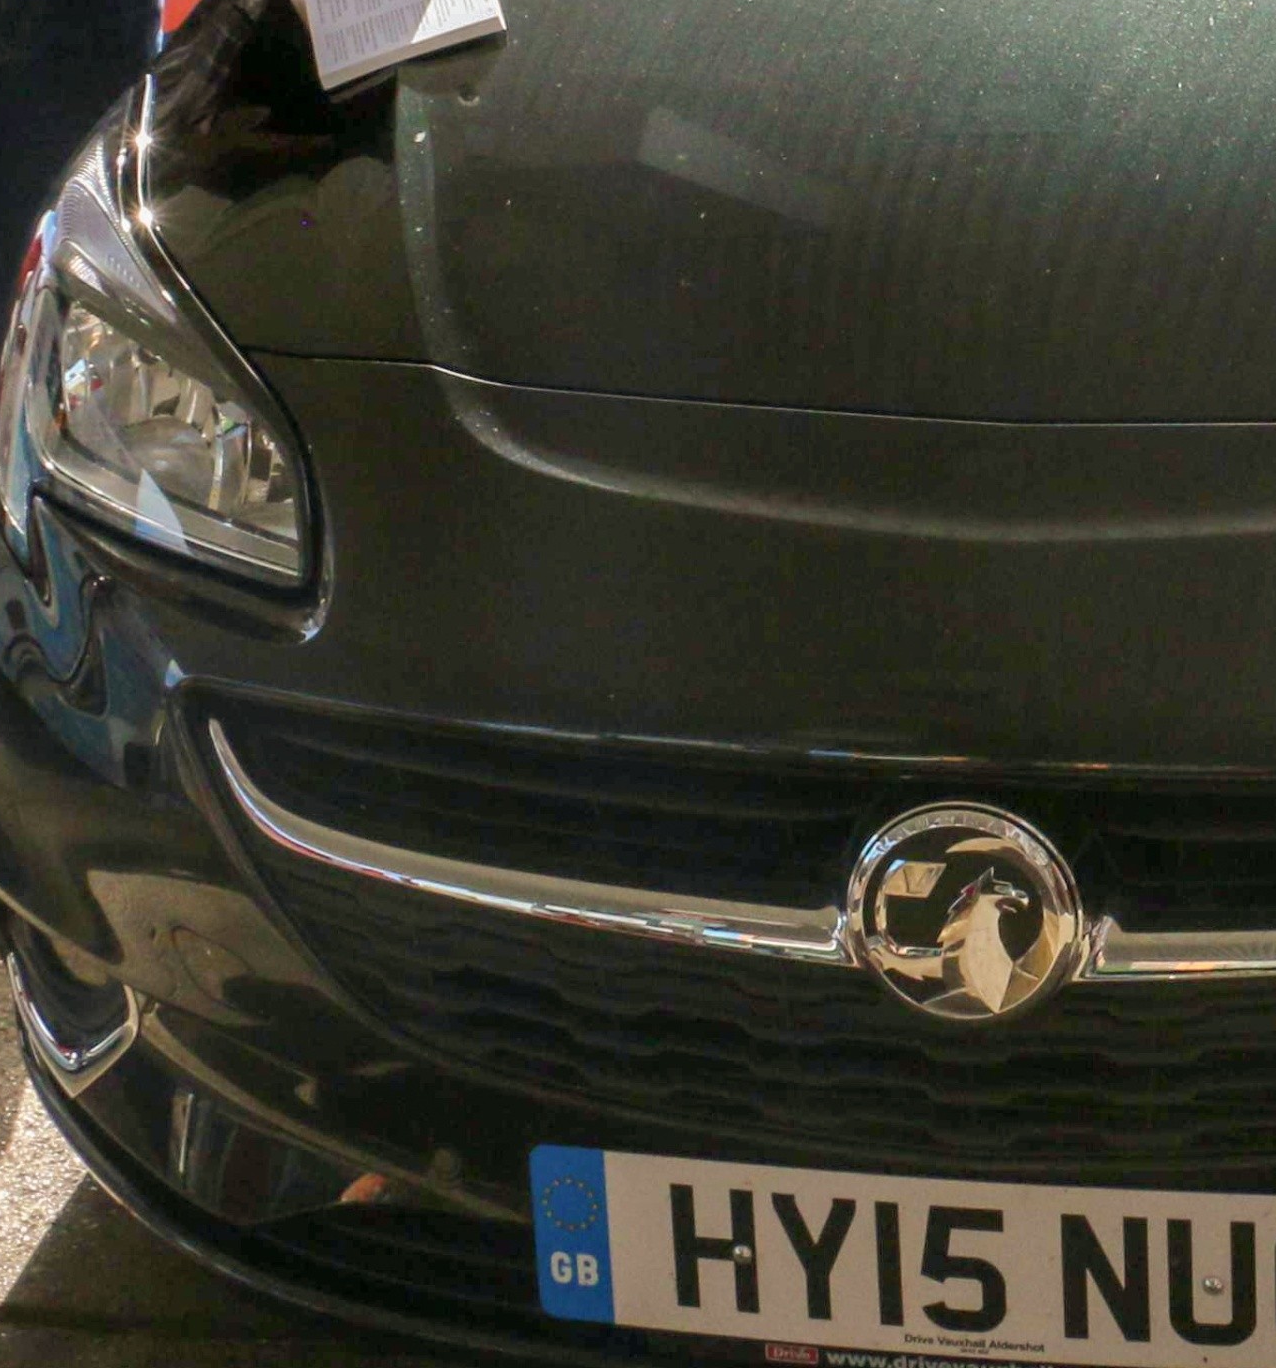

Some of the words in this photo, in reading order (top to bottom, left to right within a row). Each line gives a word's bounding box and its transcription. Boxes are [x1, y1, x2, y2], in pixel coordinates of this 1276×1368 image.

[549, 1250, 600, 1288] GB
[669, 1183, 1008, 1334] HY15
[904, 1333, 935, 1345] Drive
[937, 1336, 987, 1348] Vauxhall
[989, 1340, 1046, 1353] Aldershot
